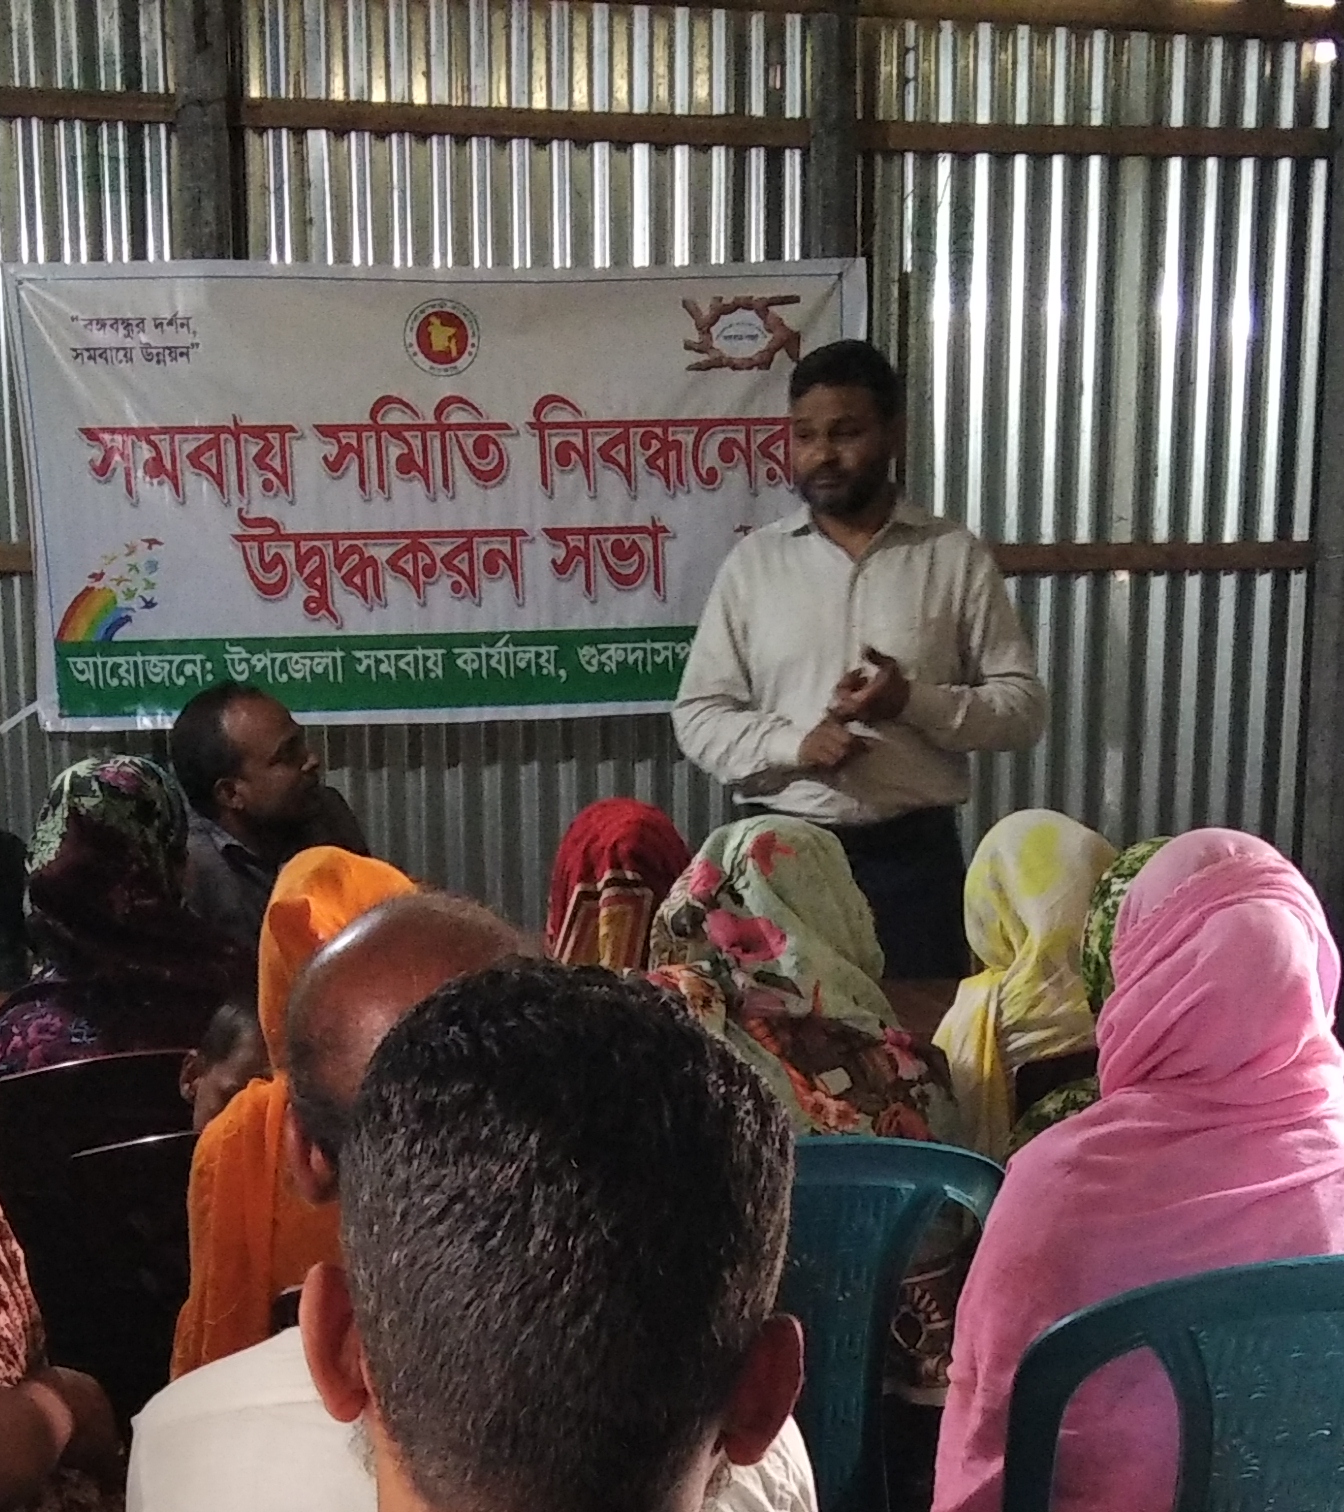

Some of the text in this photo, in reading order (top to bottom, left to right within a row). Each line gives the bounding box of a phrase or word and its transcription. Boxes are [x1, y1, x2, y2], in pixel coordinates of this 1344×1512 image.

[151, 310, 198, 337] দর্শন,
[69, 345, 135, 366] সমবায়ে
[76, 393, 794, 505] সমবায় সমিতি নিবন্ধনের
[229, 507, 674, 630] উদ্বুদ্ধকরন সভা
[222, 640, 346, 684] উপজেলা
[351, 645, 448, 682] সমবায়
[452, 633, 568, 684] কার্যালয়,
